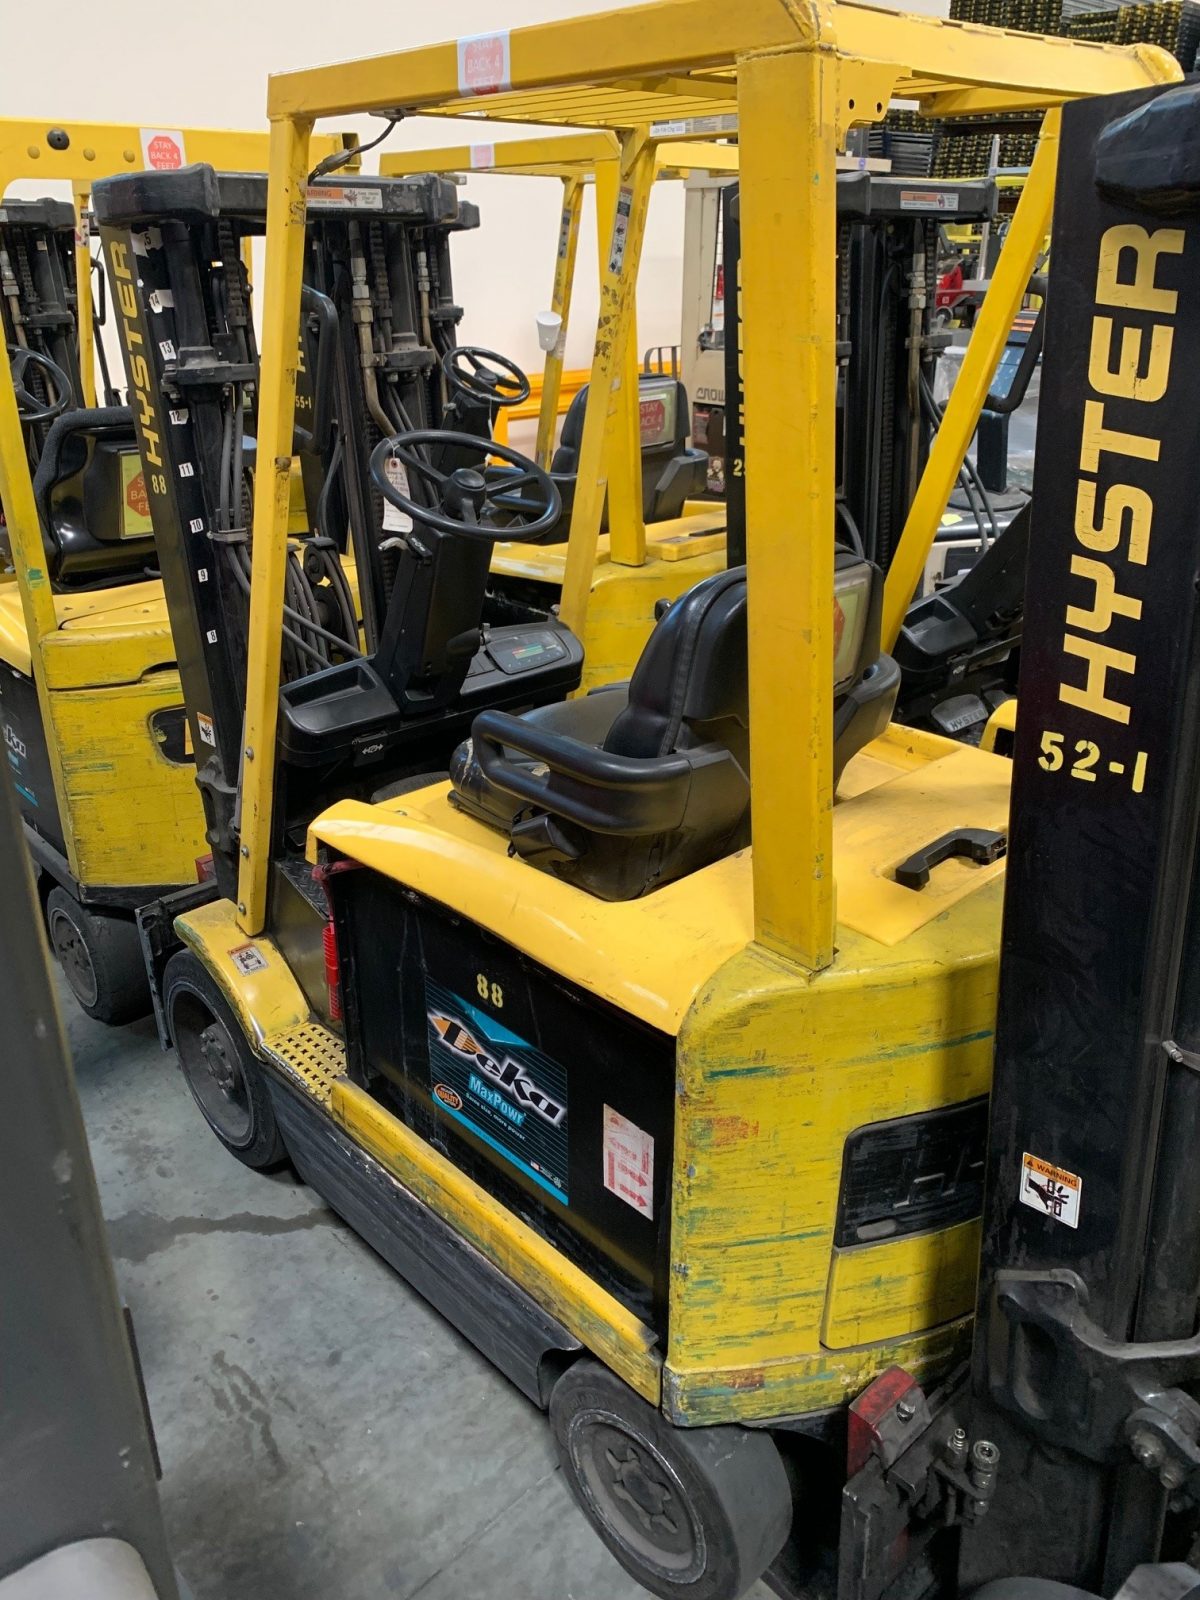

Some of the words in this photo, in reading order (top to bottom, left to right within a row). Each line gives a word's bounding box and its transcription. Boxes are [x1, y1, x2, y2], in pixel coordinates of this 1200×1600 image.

[153, 142, 172, 151] STAY
[151, 150, 171, 159] BACK
[156, 161, 176, 170] FEET
[306, 188, 333, 198] ARNING
[150, 293, 160, 307] 14
[110, 240, 163, 468] HYSTER
[161, 343, 172, 355] 13
[171, 411, 182, 423] 12
[181, 464, 192, 477] 11
[1059, 223, 1186, 725] HYSTER
[151, 474, 167, 495] 88
[191, 519, 202, 532] 10
[200, 569, 206, 581] 9
[210, 630, 217, 642] 8
[950, 708, 988, 730] HYSTER
[1038, 730, 1148, 793] 52-1
[476, 973, 503, 1008] 88
[429, 1012, 562, 1122] Deka
[437, 1088, 460, 1105] QUALITY
[1036, 1163, 1078, 1188] WARNING
